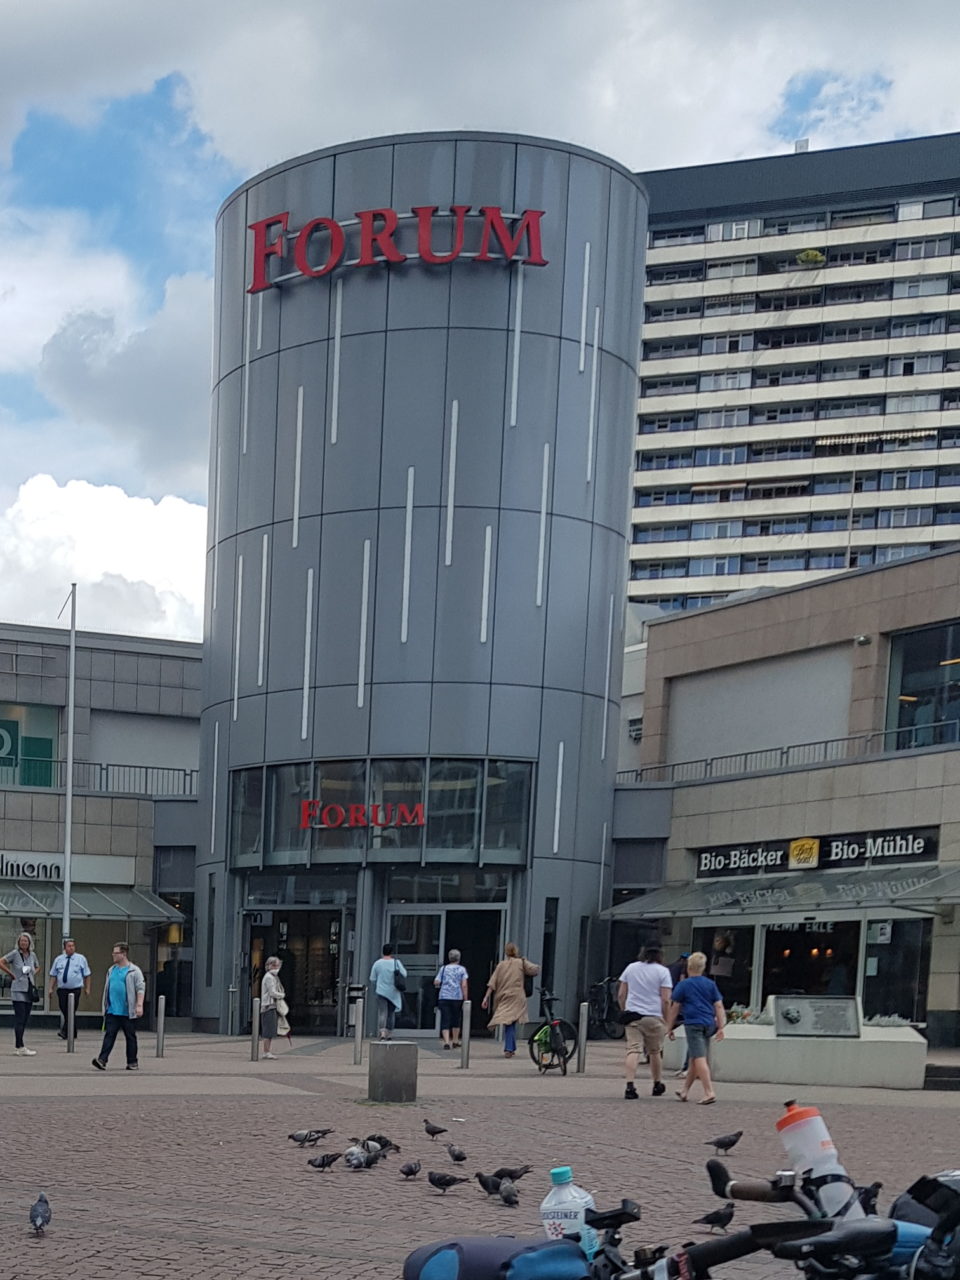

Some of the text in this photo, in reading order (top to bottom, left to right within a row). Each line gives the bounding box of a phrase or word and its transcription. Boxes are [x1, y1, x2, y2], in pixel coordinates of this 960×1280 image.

[246, 205, 549, 294] FORUM
[299, 800, 425, 830] FORUM
[699, 834, 925, 871] Bio-Bäcker Bio-Mühle
